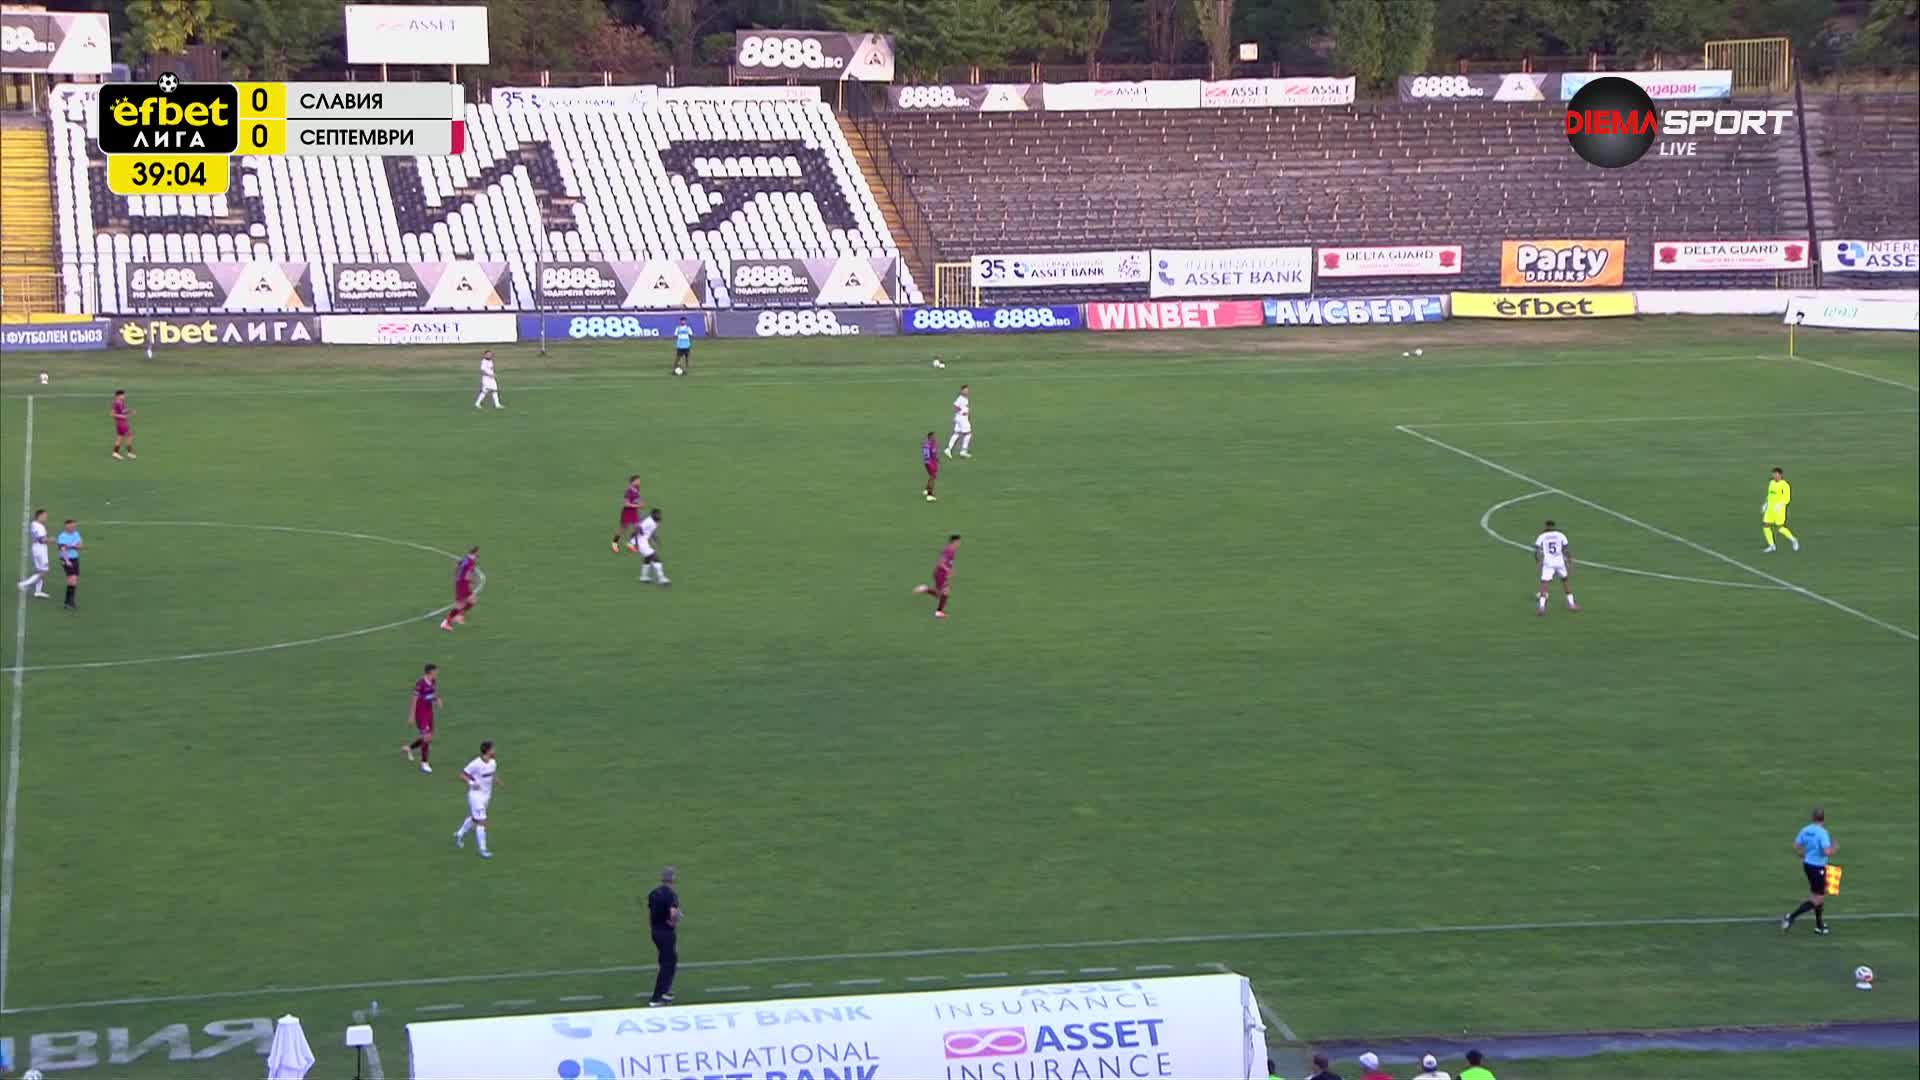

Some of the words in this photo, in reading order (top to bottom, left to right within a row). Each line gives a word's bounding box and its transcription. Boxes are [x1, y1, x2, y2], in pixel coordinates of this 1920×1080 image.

[1346, 251, 1385, 260] DELTA
[1389, 250, 1433, 259] GUARD
[1684, 245, 1726, 255] DELTA
[1730, 244, 1778, 254] GUARD
[981, 259, 1006, 279] 35
[1517, 243, 1609, 278] Party
[1866, 253, 1919, 267] ASSE
[1031, 269, 1066, 278] ASSET
[1072, 267, 1104, 277] BANK
[1185, 272, 1243, 285] ASSET
[1250, 270, 1302, 283] BANK
[1525, 270, 1586, 283] DRINKS
[1098, 302, 1220, 330] WINBET
[1275, 299, 1429, 326] АИСБЕРГ
[1495, 297, 1593, 316] efbet
[6, 330, 68, 344] ФУТБОЛЕН
[69, 329, 103, 344] СЪЮЗ
[222, 321, 312, 343] ЛИГА
[412, 323, 460, 334] ASSET
[1548, 542, 1557, 554] 5
[936, 992, 1160, 1020] INSURANCE
[616, 1012, 740, 1035] ASSET
[755, 1006, 873, 1026] BANK
[1034, 1018, 1164, 1053] ASSET
[619, 1041, 880, 1078] INTERNATIONAL
[948, 1053, 1172, 1080] INSURANCE
